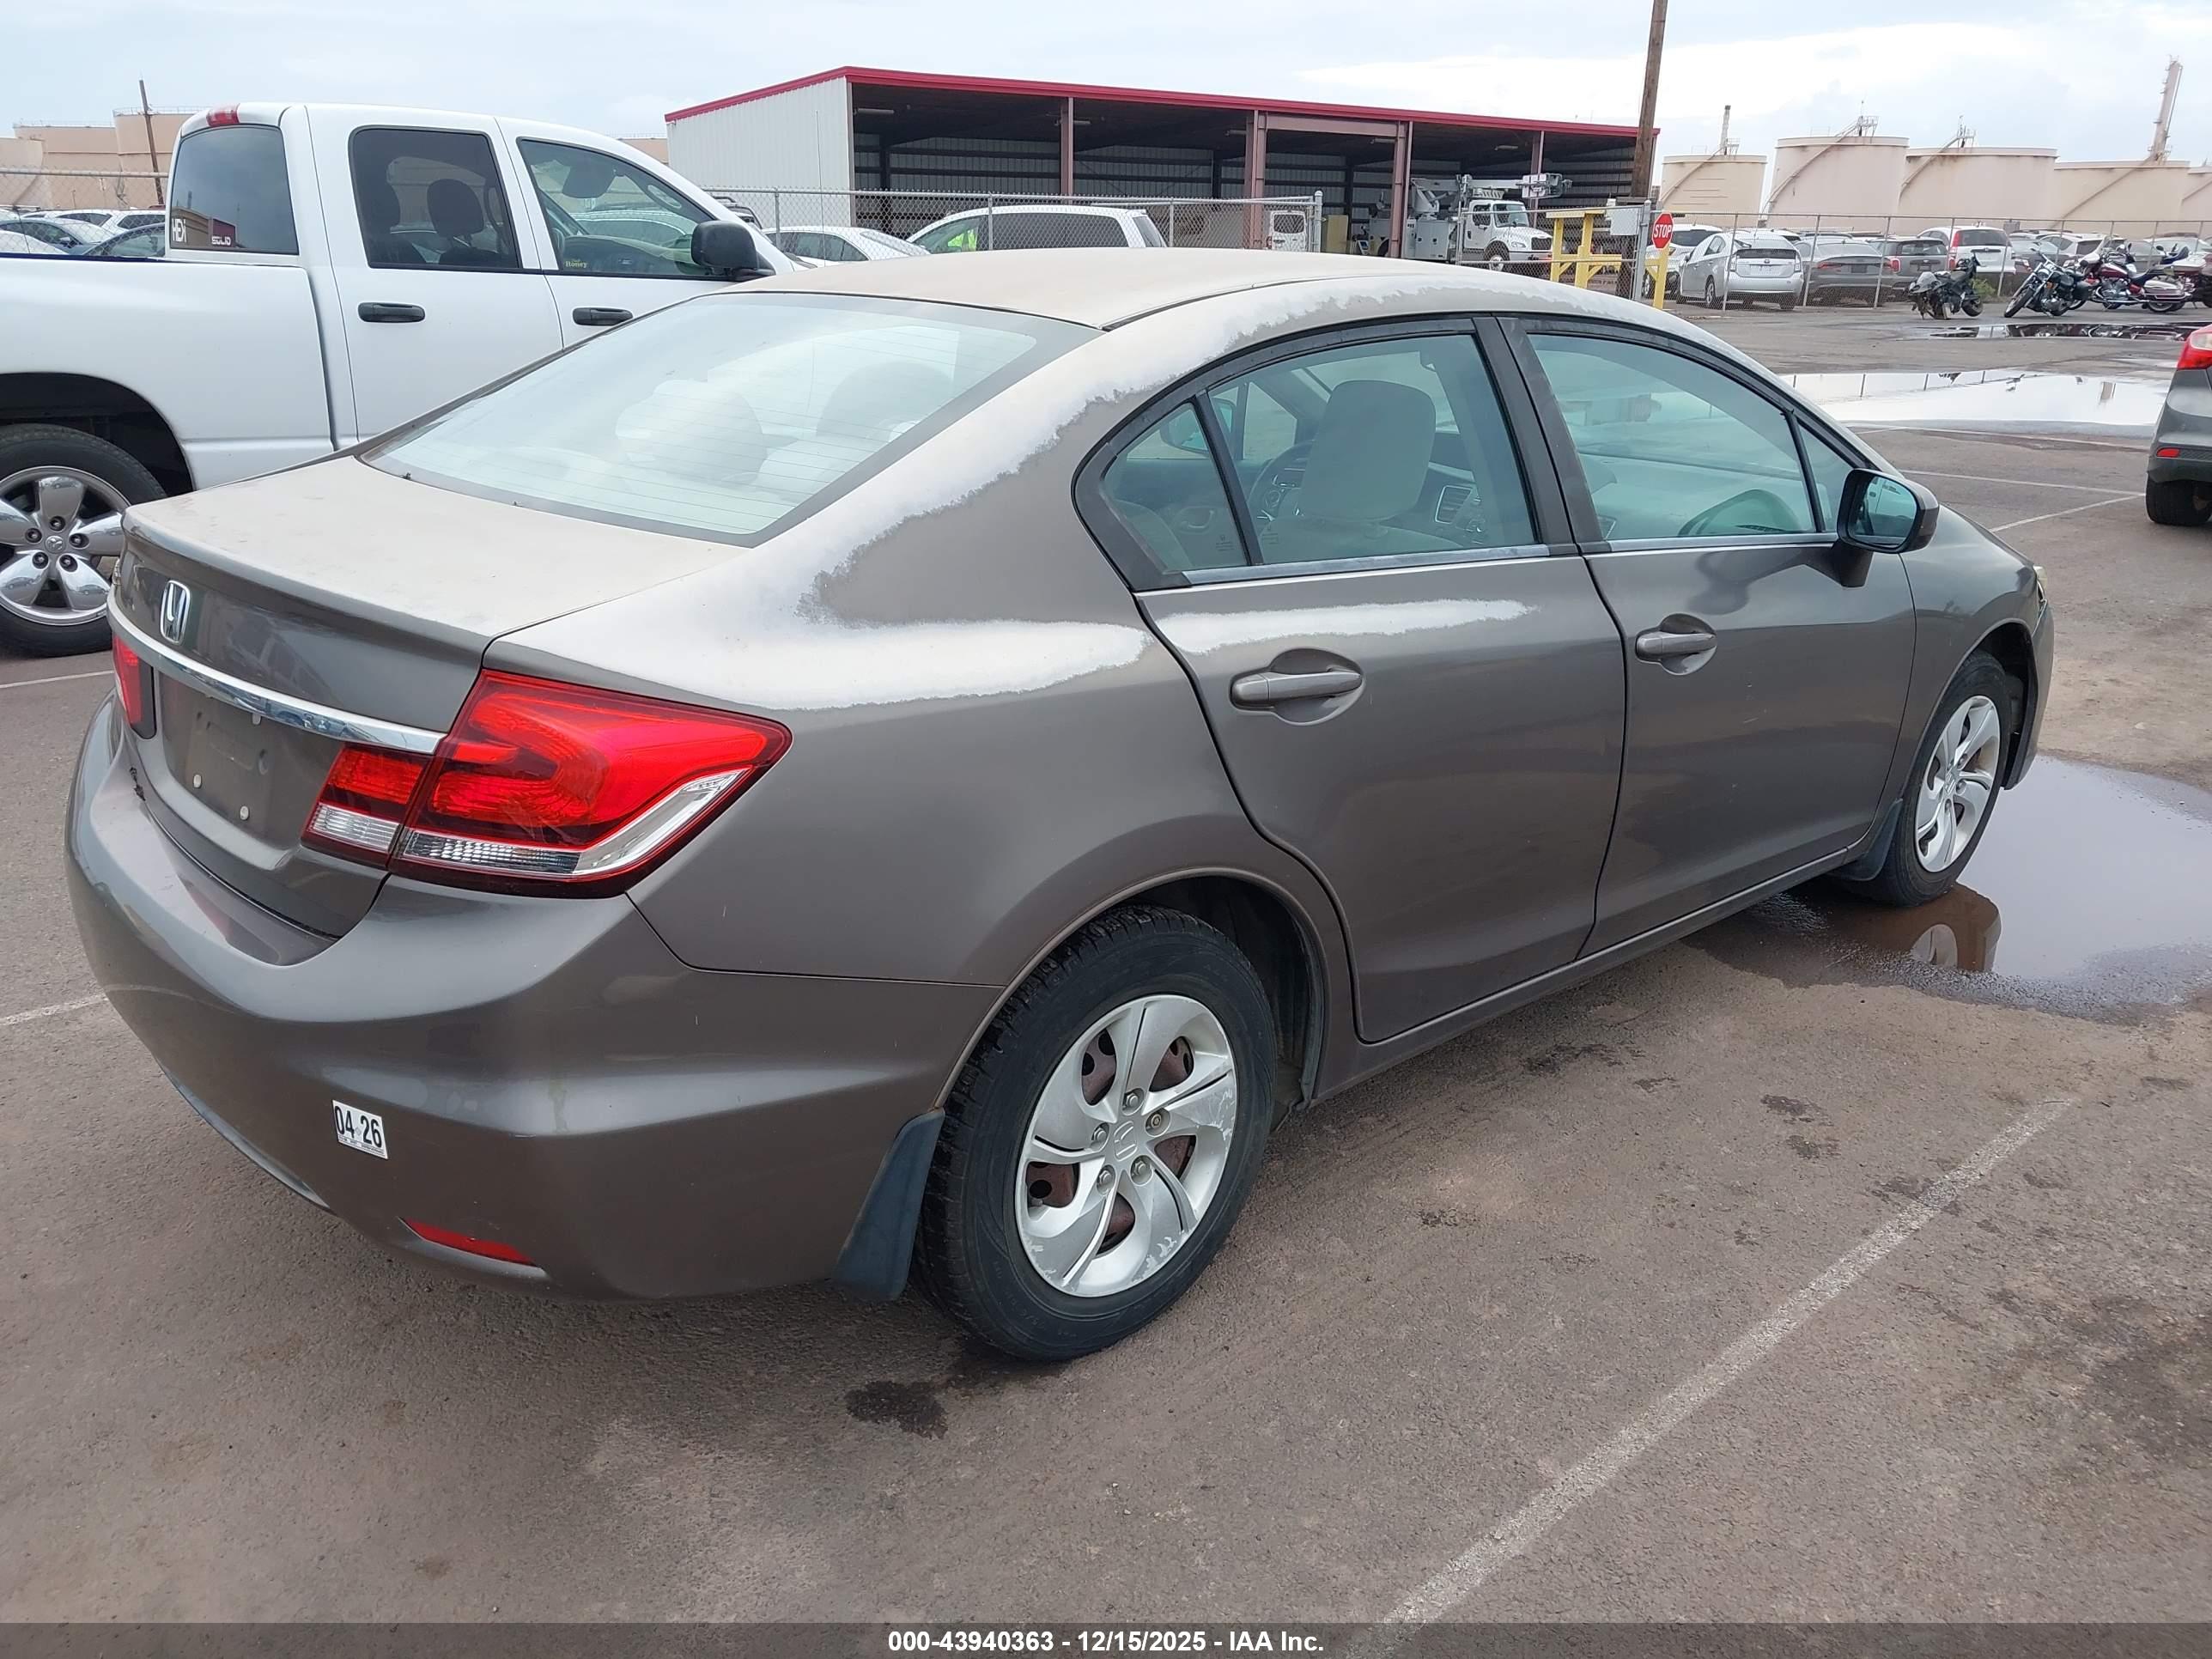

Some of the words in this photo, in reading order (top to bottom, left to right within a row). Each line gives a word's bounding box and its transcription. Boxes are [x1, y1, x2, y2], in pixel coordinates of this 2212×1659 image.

[1654, 224, 1673, 239] STOP
[334, 1105, 355, 1139] 04
[360, 1115, 383, 1148] 26
